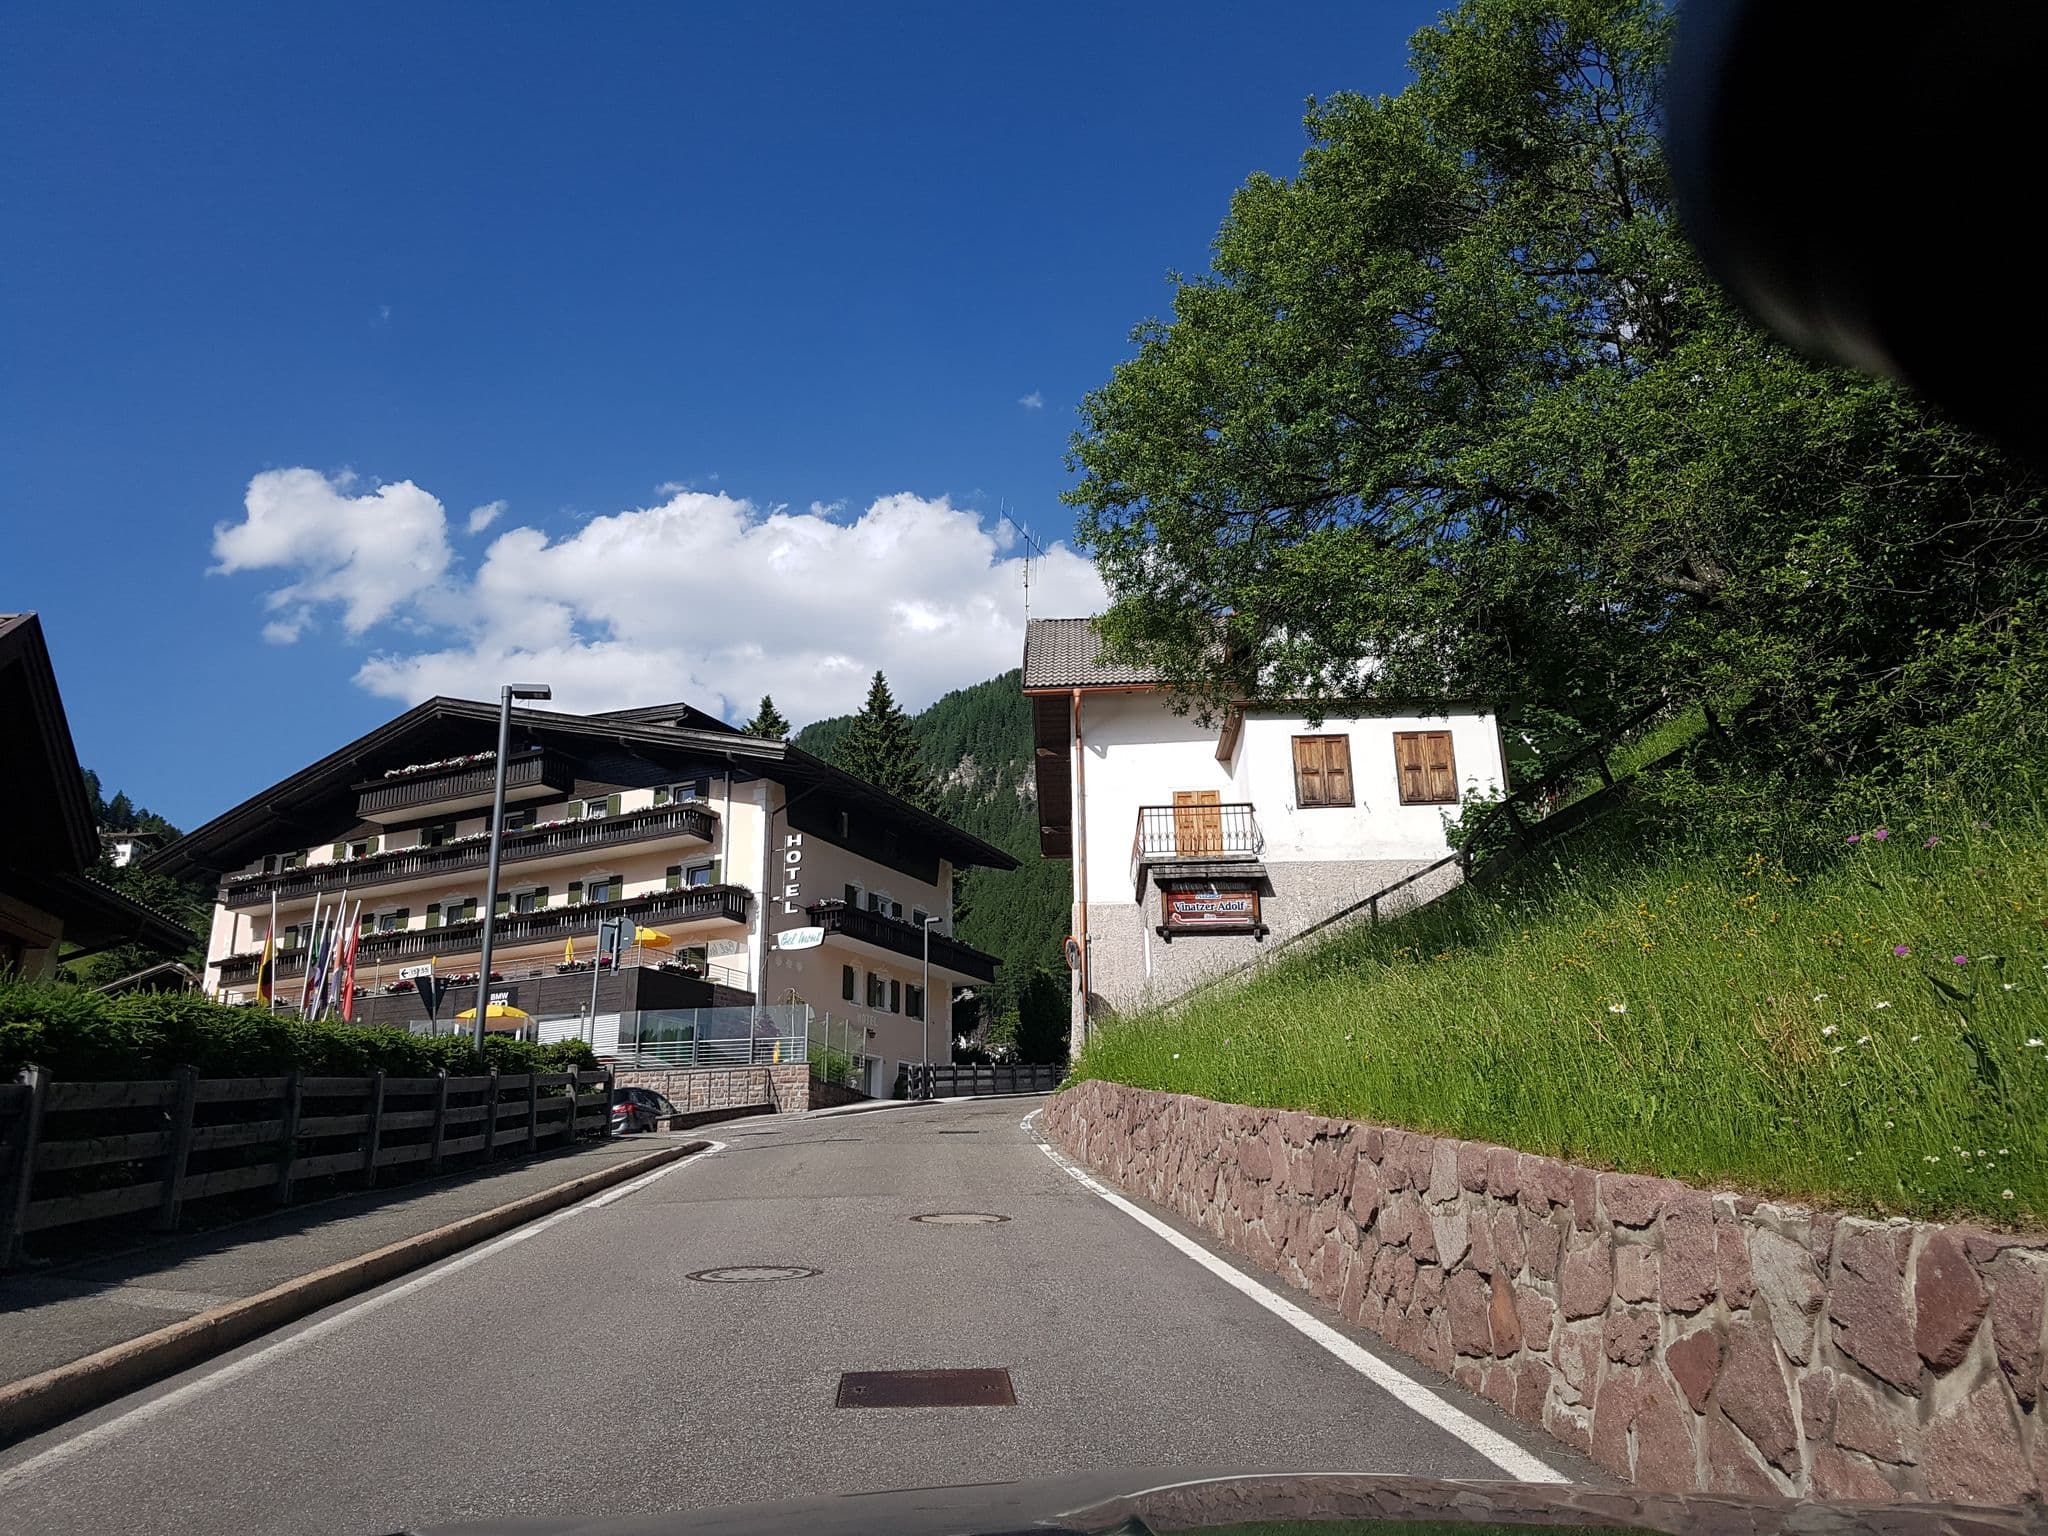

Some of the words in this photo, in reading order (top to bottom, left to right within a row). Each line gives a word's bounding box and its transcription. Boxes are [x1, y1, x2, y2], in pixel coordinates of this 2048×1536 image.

[785, 833, 802, 914] HOTEL
[1174, 901, 1215, 911] Vinatzer
[1218, 901, 1246, 911] Adolf
[490, 991, 509, 1001] BMW
